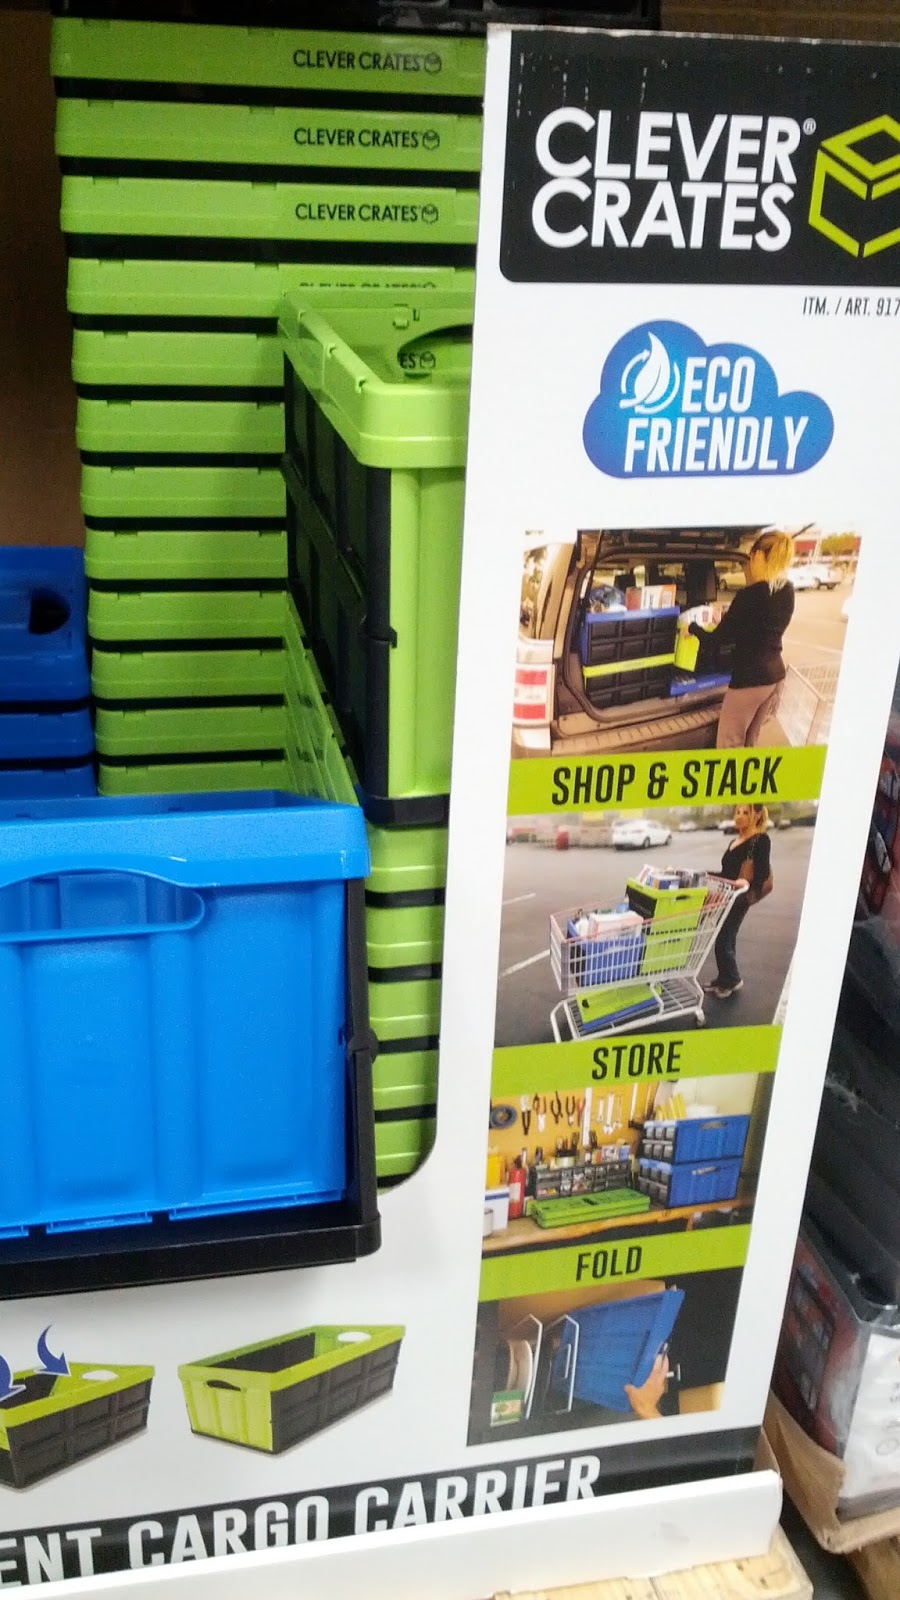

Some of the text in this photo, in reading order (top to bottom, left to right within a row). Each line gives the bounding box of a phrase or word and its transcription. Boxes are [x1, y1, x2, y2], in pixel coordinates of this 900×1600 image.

[293, 49, 420, 72] CLEVER CRATES
[294, 127, 419, 148] CLEVER CRATES
[295, 203, 418, 223] CLEVER CRATES
[532, 177, 795, 252] CRATES
[802, 296, 830, 316] ITM.
[844, 297, 870, 316] ART.
[681, 355, 756, 414] ECO
[624, 415, 810, 473] FRIENDLY
[551, 756, 783, 806] SHOP & STACK
[591, 1040, 684, 1081] STORE
[575, 1245, 643, 1282] FOLD
[128, 1495, 330, 1569] CARGO
[354, 1454, 601, 1536] CARRIER
